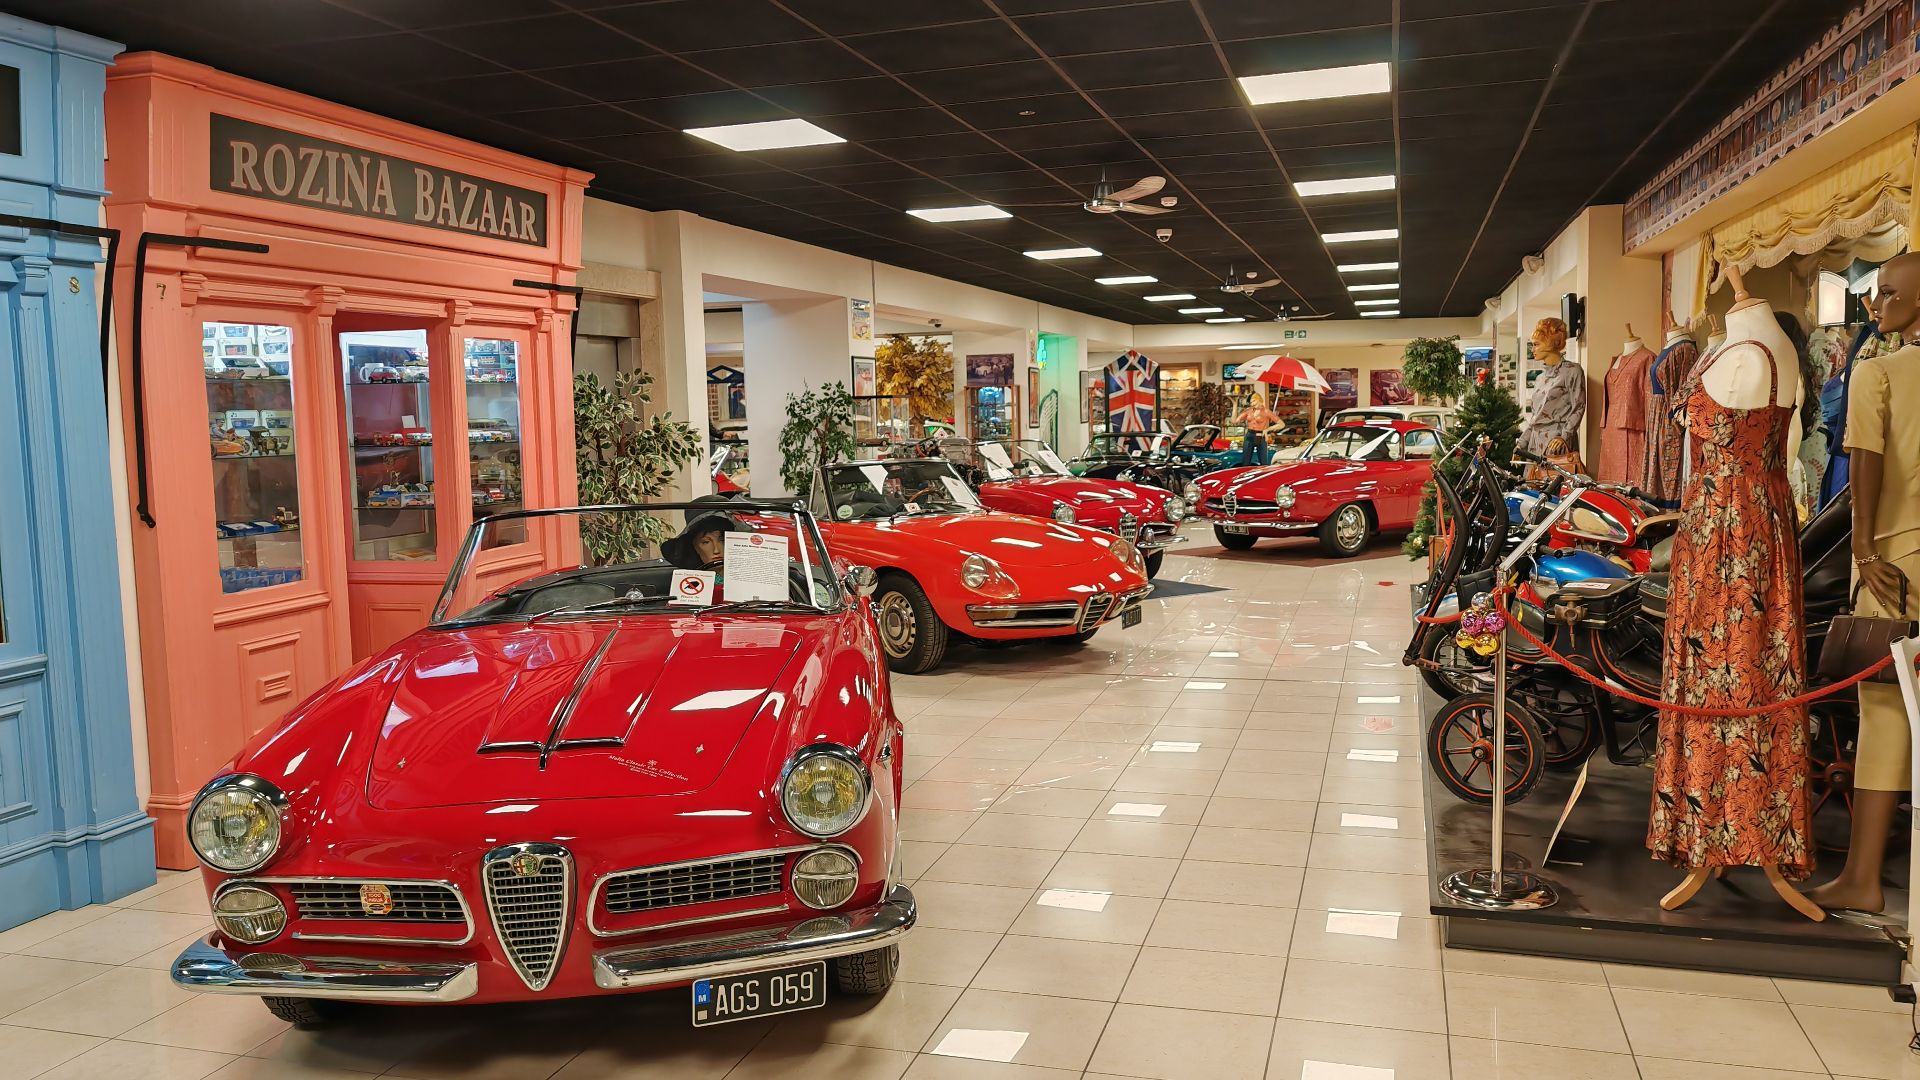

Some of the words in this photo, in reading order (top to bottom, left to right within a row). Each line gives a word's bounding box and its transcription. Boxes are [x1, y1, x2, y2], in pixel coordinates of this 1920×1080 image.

[230, 140, 397, 216] ROZINA
[414, 168, 538, 242] BAZAAR
[69, 276, 80, 294] 8
[156, 283, 167, 300] 7
[608, 755, 625, 763] Malta
[626, 759, 647, 769] Classic
[659, 768, 689, 782] Collection
[698, 993, 707, 1003] M
[716, 979, 760, 1016] AGS
[770, 971, 814, 1007] 059
